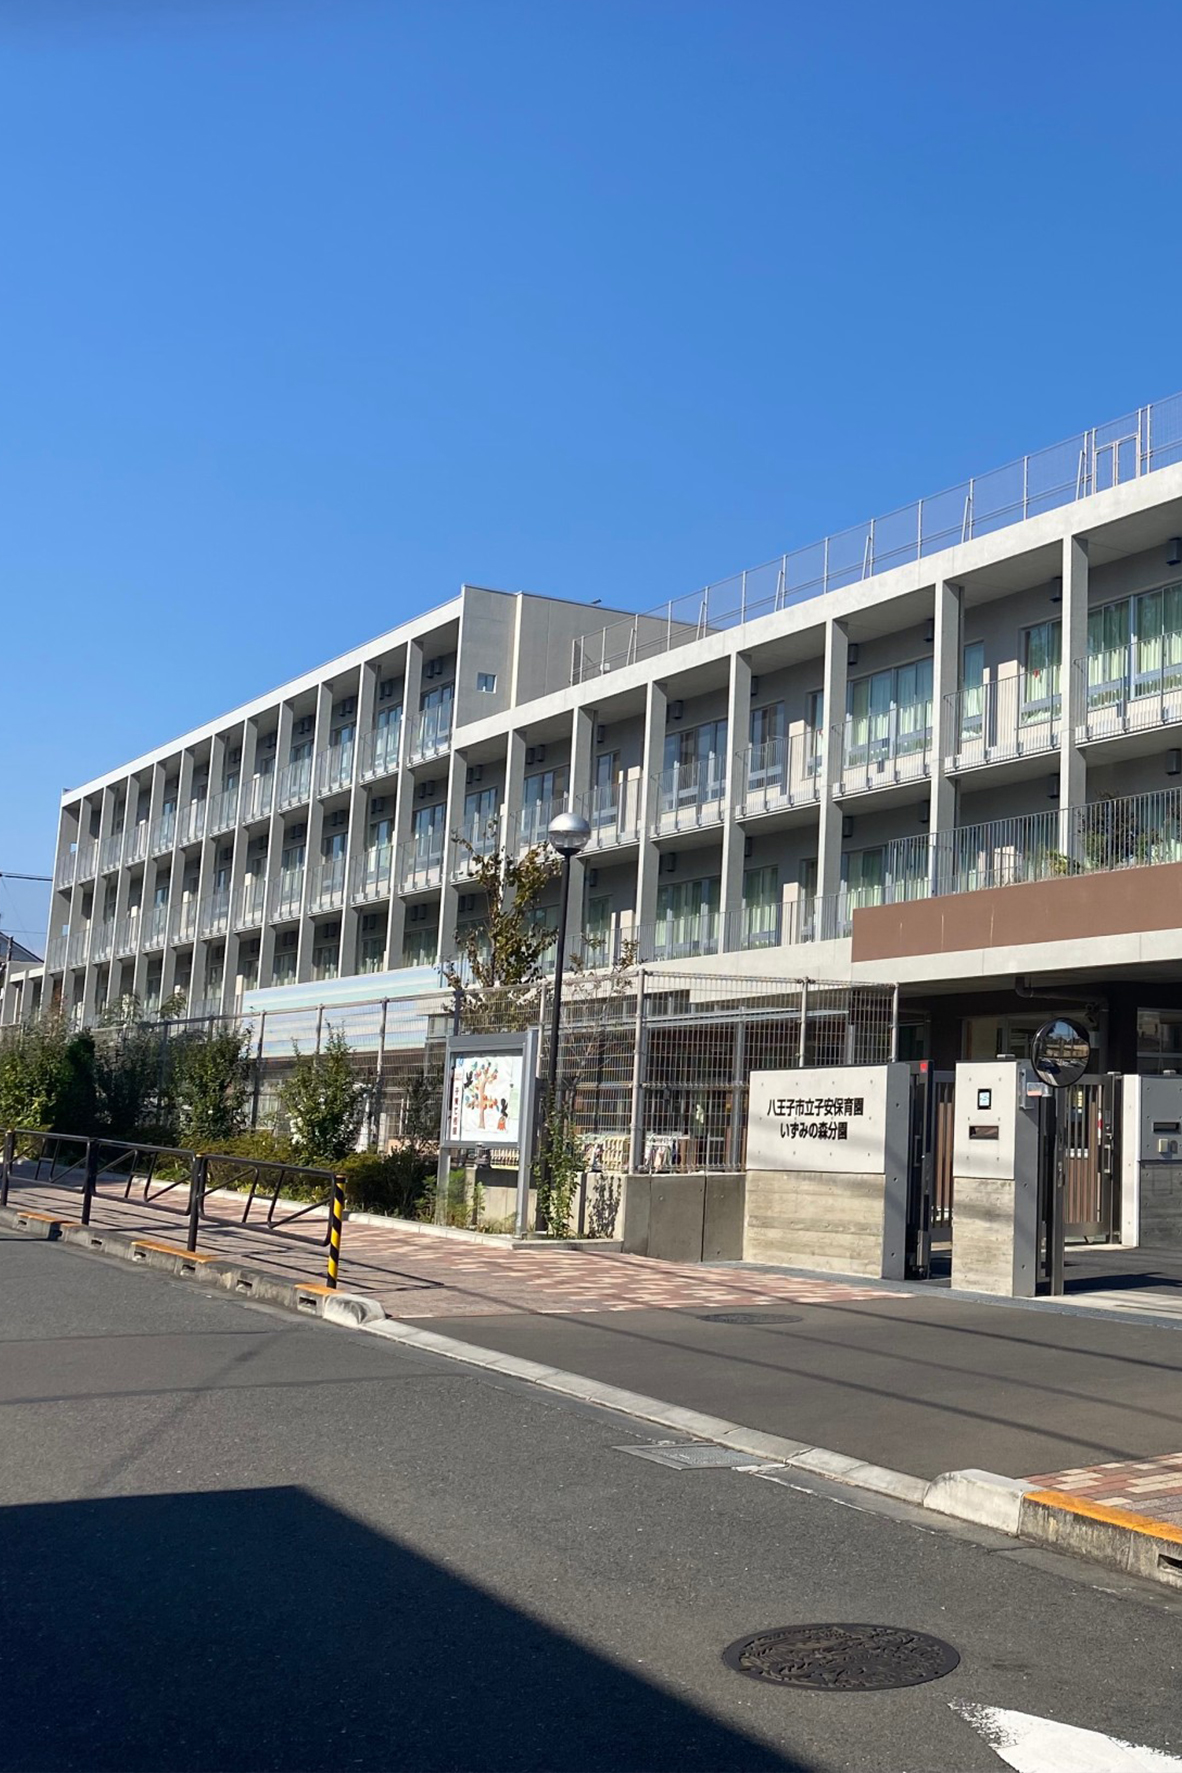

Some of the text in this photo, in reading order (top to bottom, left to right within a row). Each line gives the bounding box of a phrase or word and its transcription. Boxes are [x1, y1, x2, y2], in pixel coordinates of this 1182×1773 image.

[767, 1098, 863, 1116] 八王子市立子安保育園
[781, 1122, 847, 1140] いずみの森分園
